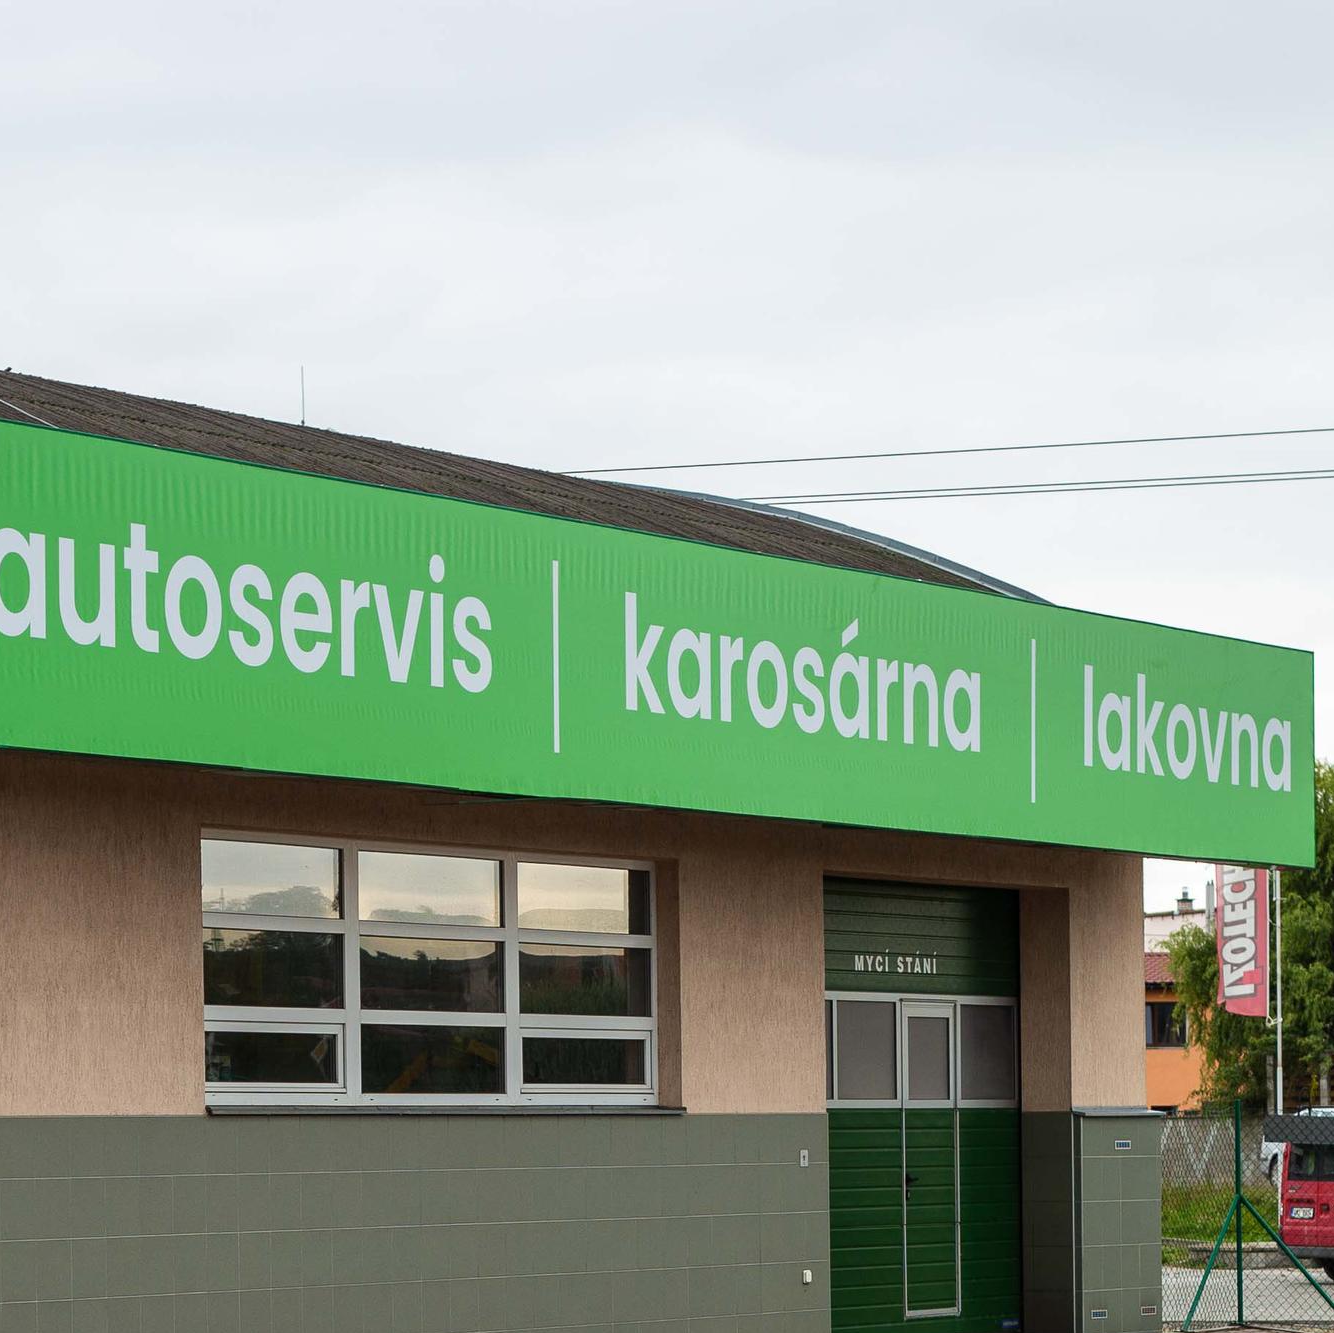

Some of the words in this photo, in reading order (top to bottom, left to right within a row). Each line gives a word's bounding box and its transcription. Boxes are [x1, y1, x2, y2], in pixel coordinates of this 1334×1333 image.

[624, 591, 982, 753] karosárna
[1083, 663, 1292, 793] lakovna
[854, 948, 890, 972] MYCÍ
[897, 950, 937, 974] STÁNÍ
